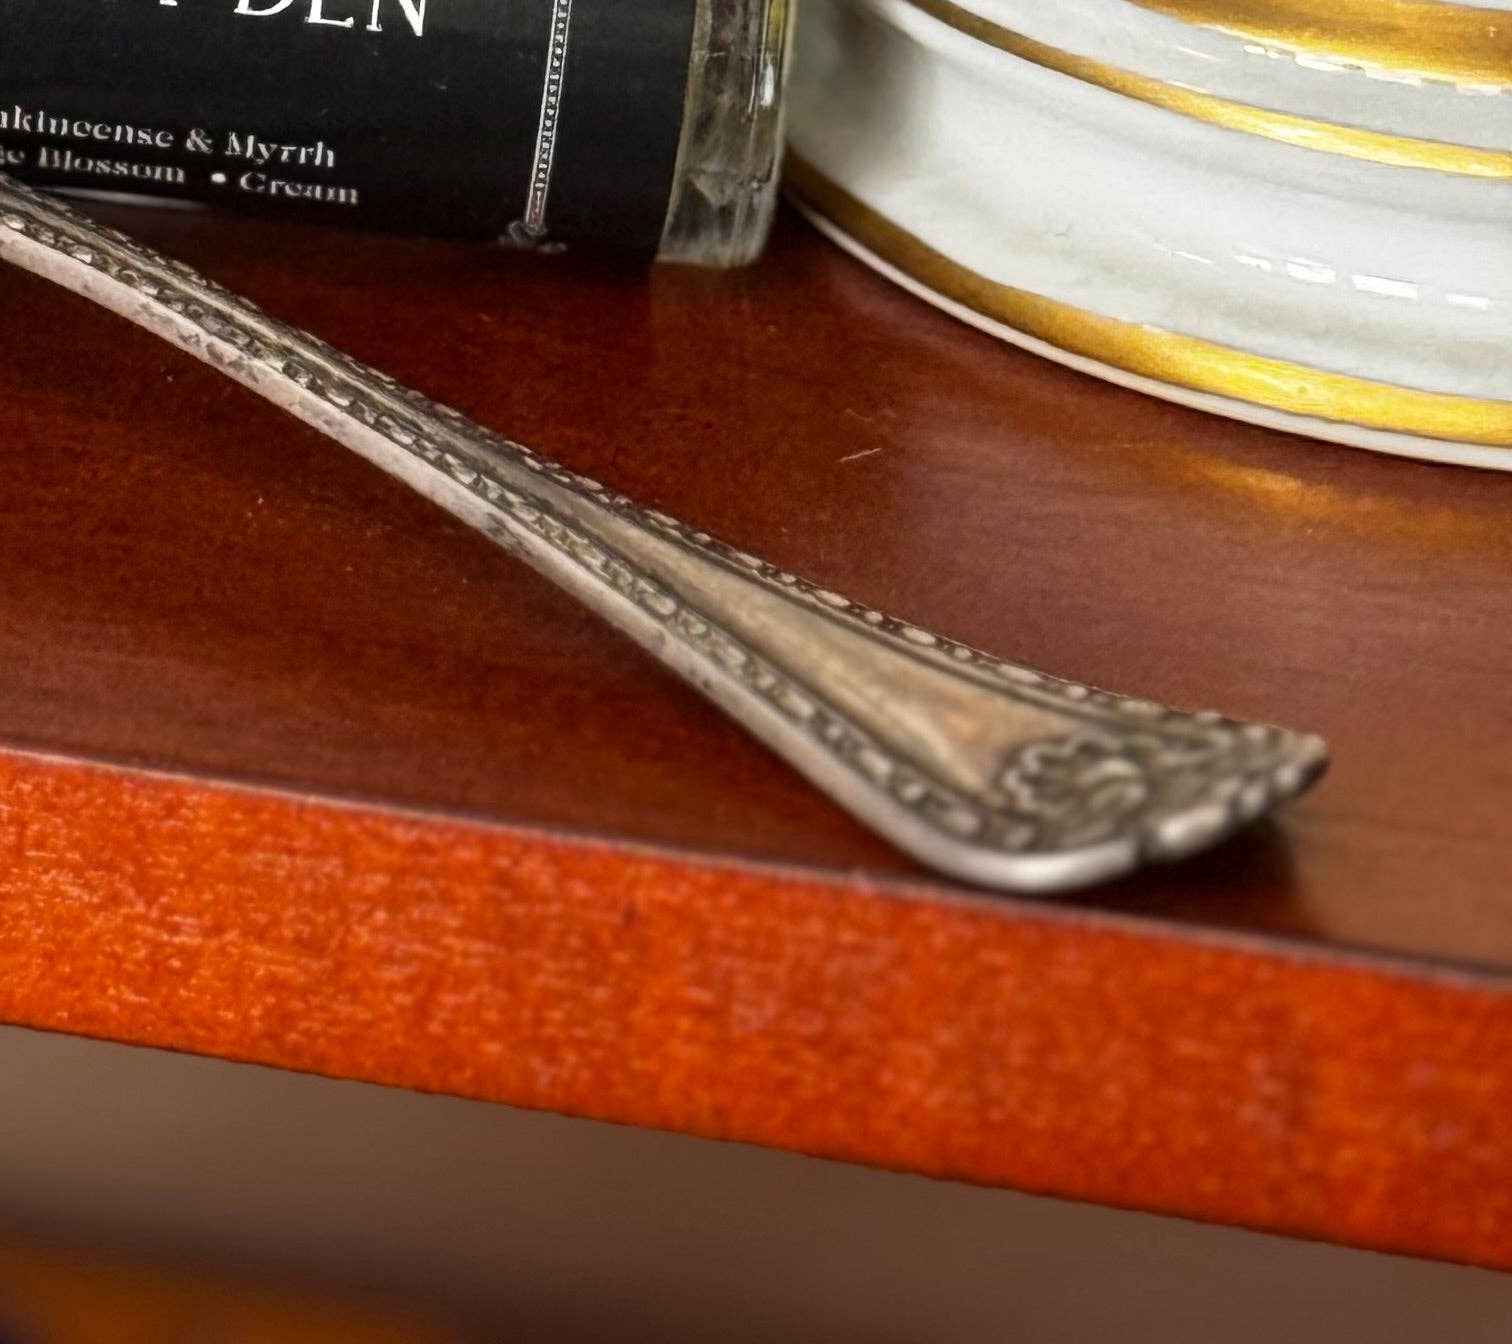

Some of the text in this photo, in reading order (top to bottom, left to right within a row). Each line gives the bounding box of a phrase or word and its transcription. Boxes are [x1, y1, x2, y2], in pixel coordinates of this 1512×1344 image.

[185, 127, 214, 154] &
[224, 131, 335, 168] Myrrh
[38, 146, 185, 184] Blossom
[239, 171, 358, 205] Cream
